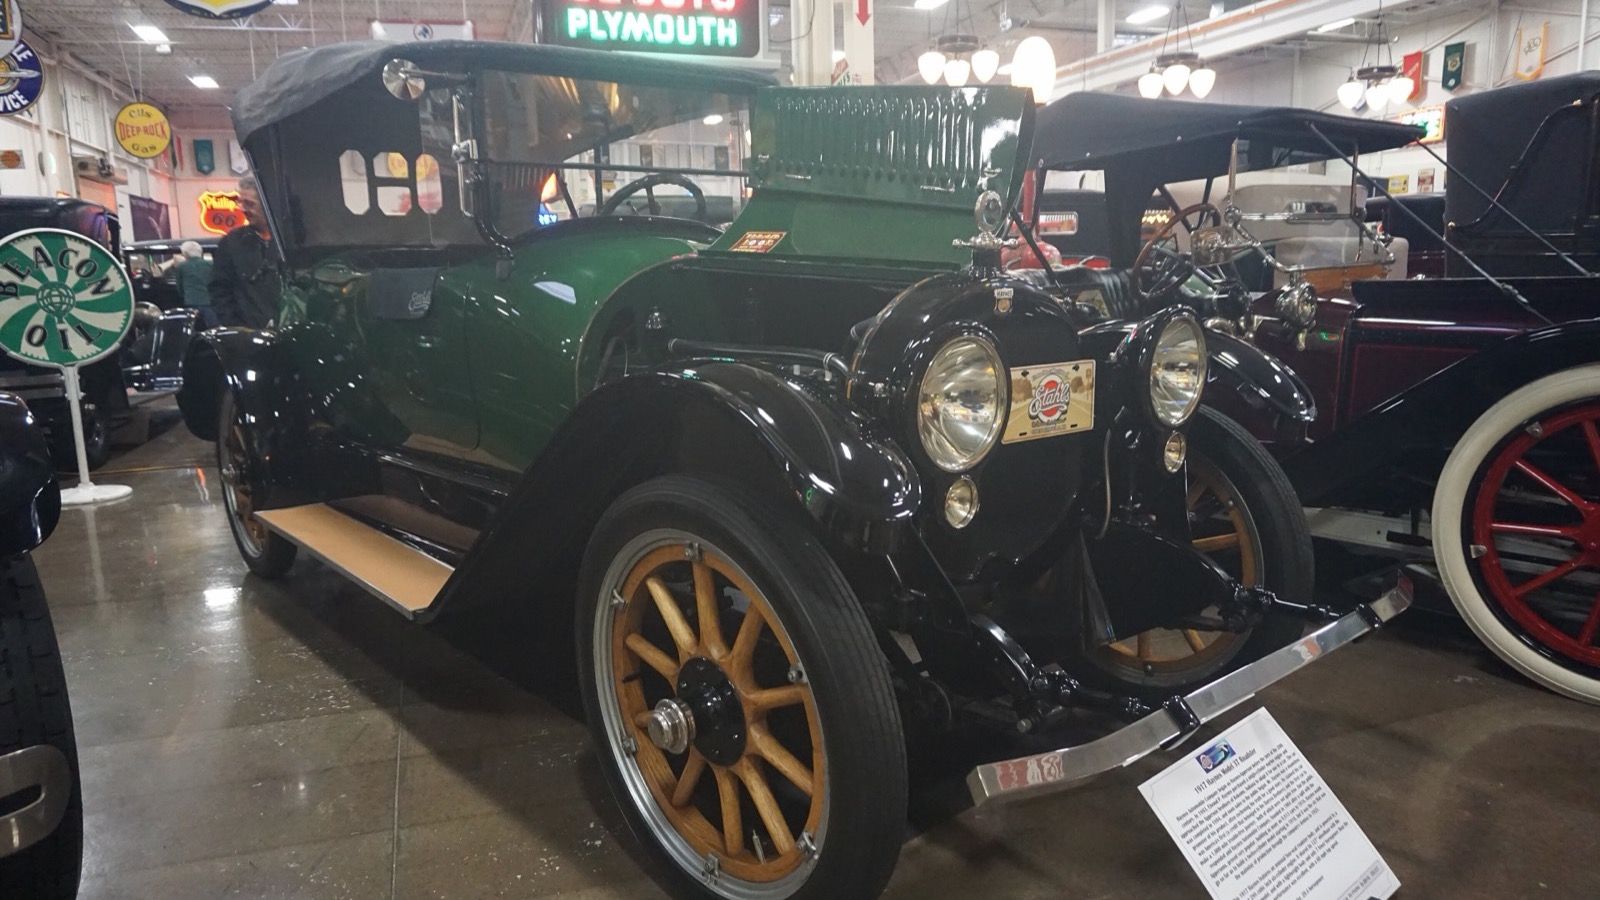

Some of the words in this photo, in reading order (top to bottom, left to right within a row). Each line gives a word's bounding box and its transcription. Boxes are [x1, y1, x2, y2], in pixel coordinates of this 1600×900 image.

[566, 7, 738, 48] PLYMOUTH
[203, 195, 237, 213] Phillip
[212, 212, 236, 228] 66
[0, 246, 115, 299] BEACON
[25, 323, 102, 352] OIL
[1193, 781, 1207, 793] 1917
[1220, 762, 1234, 775] Model
